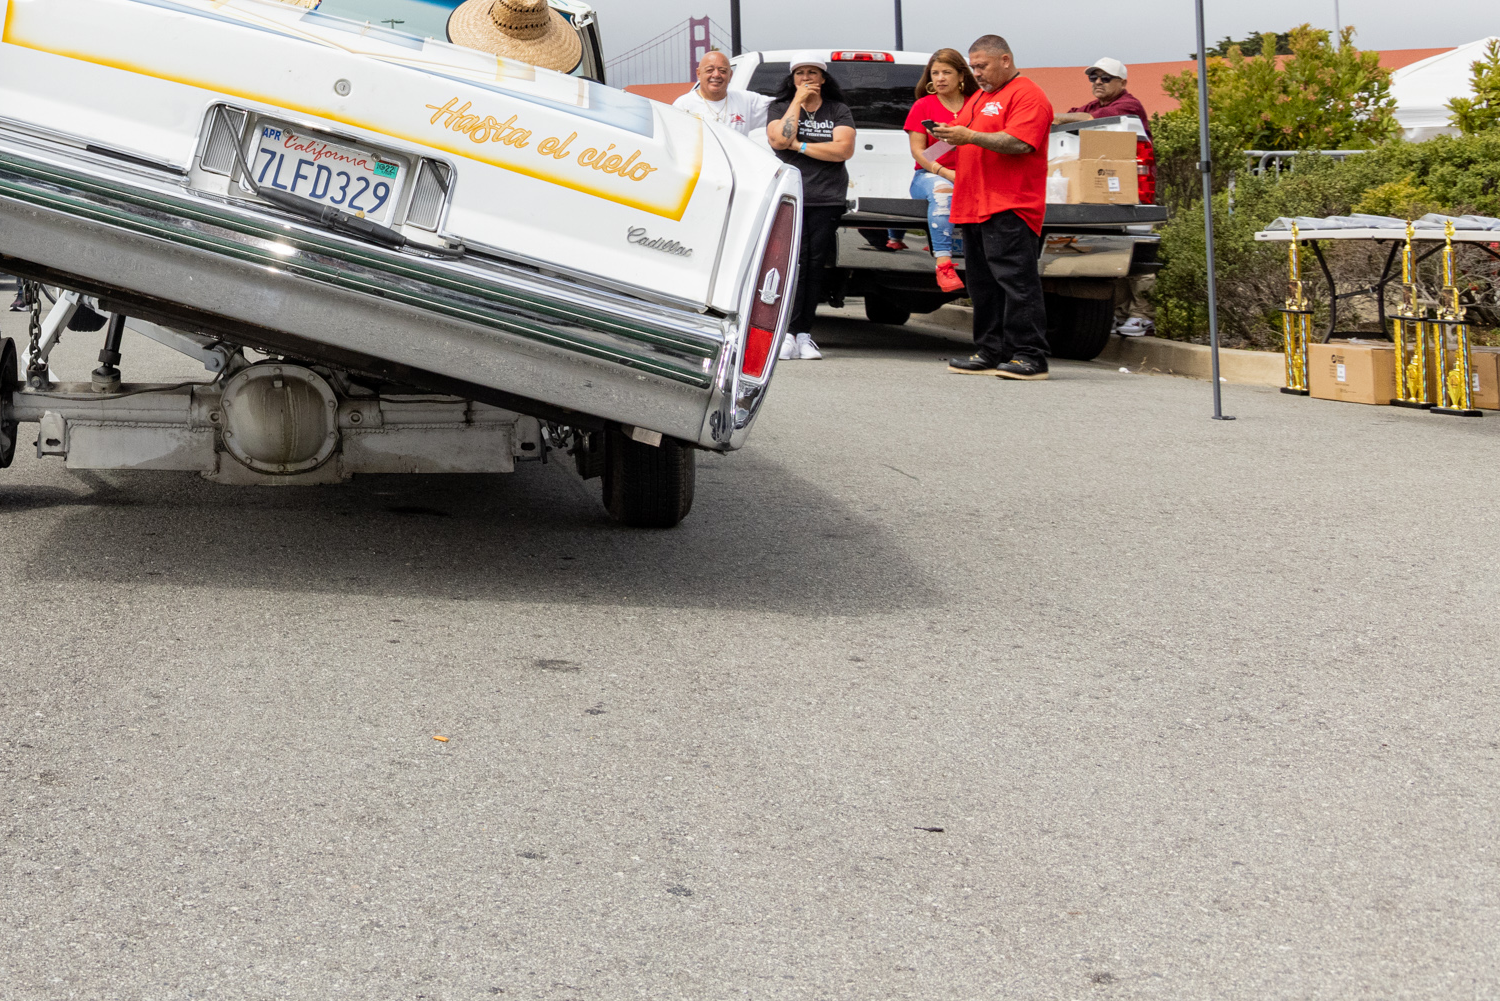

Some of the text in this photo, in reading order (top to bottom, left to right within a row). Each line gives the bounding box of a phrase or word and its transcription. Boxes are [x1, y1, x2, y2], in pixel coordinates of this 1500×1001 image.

[263, 127, 282, 141] APR
[426, 97, 657, 181] Hasta el cielo
[284, 135, 374, 172] California
[258, 147, 390, 213] 7LFD329
[627, 225, 693, 257] Cadillac
